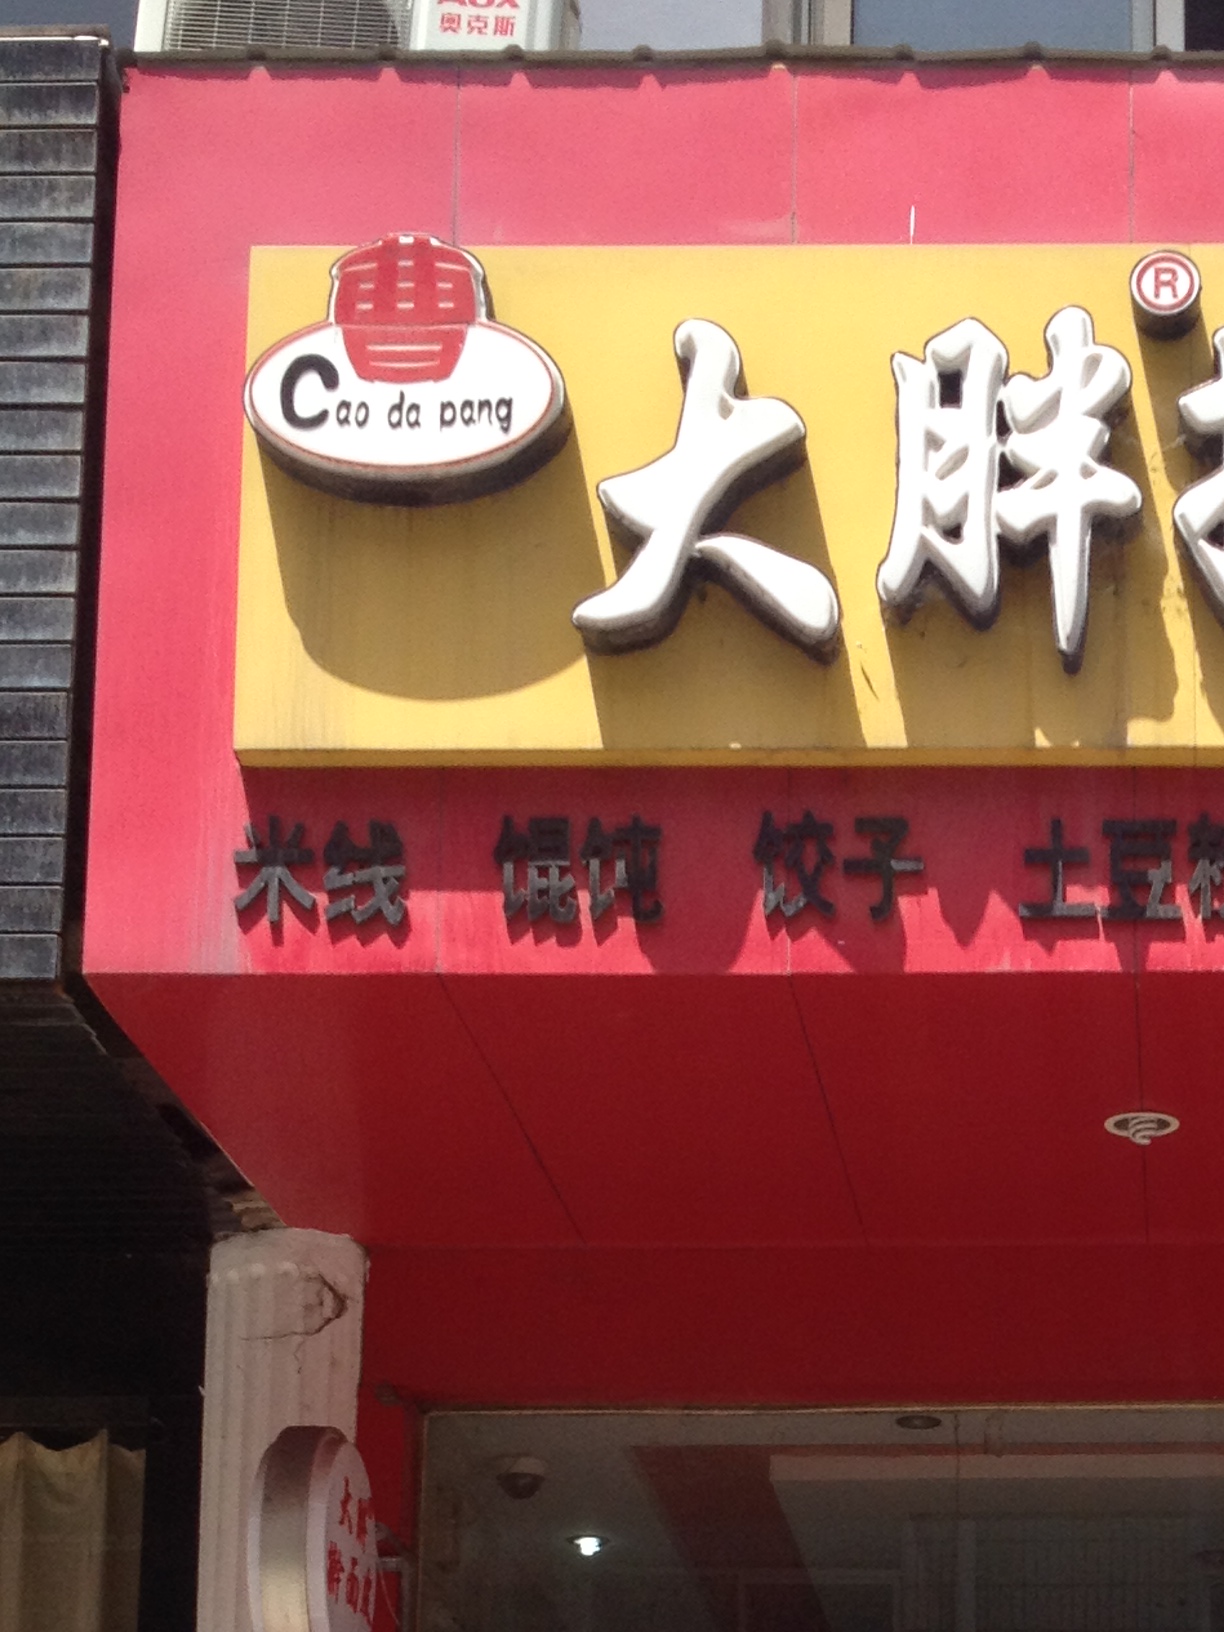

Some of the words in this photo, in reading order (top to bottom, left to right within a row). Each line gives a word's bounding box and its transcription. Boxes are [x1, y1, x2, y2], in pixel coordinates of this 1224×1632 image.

[440, 13, 516, 36] 奥克斯
[280, 353, 370, 430] Cao
[387, 390, 421, 429] da
[439, 397, 513, 435] pang
[233, 814, 407, 925] 米线
[494, 813, 664, 923] 馄饨
[753, 811, 924, 920] 饺子
